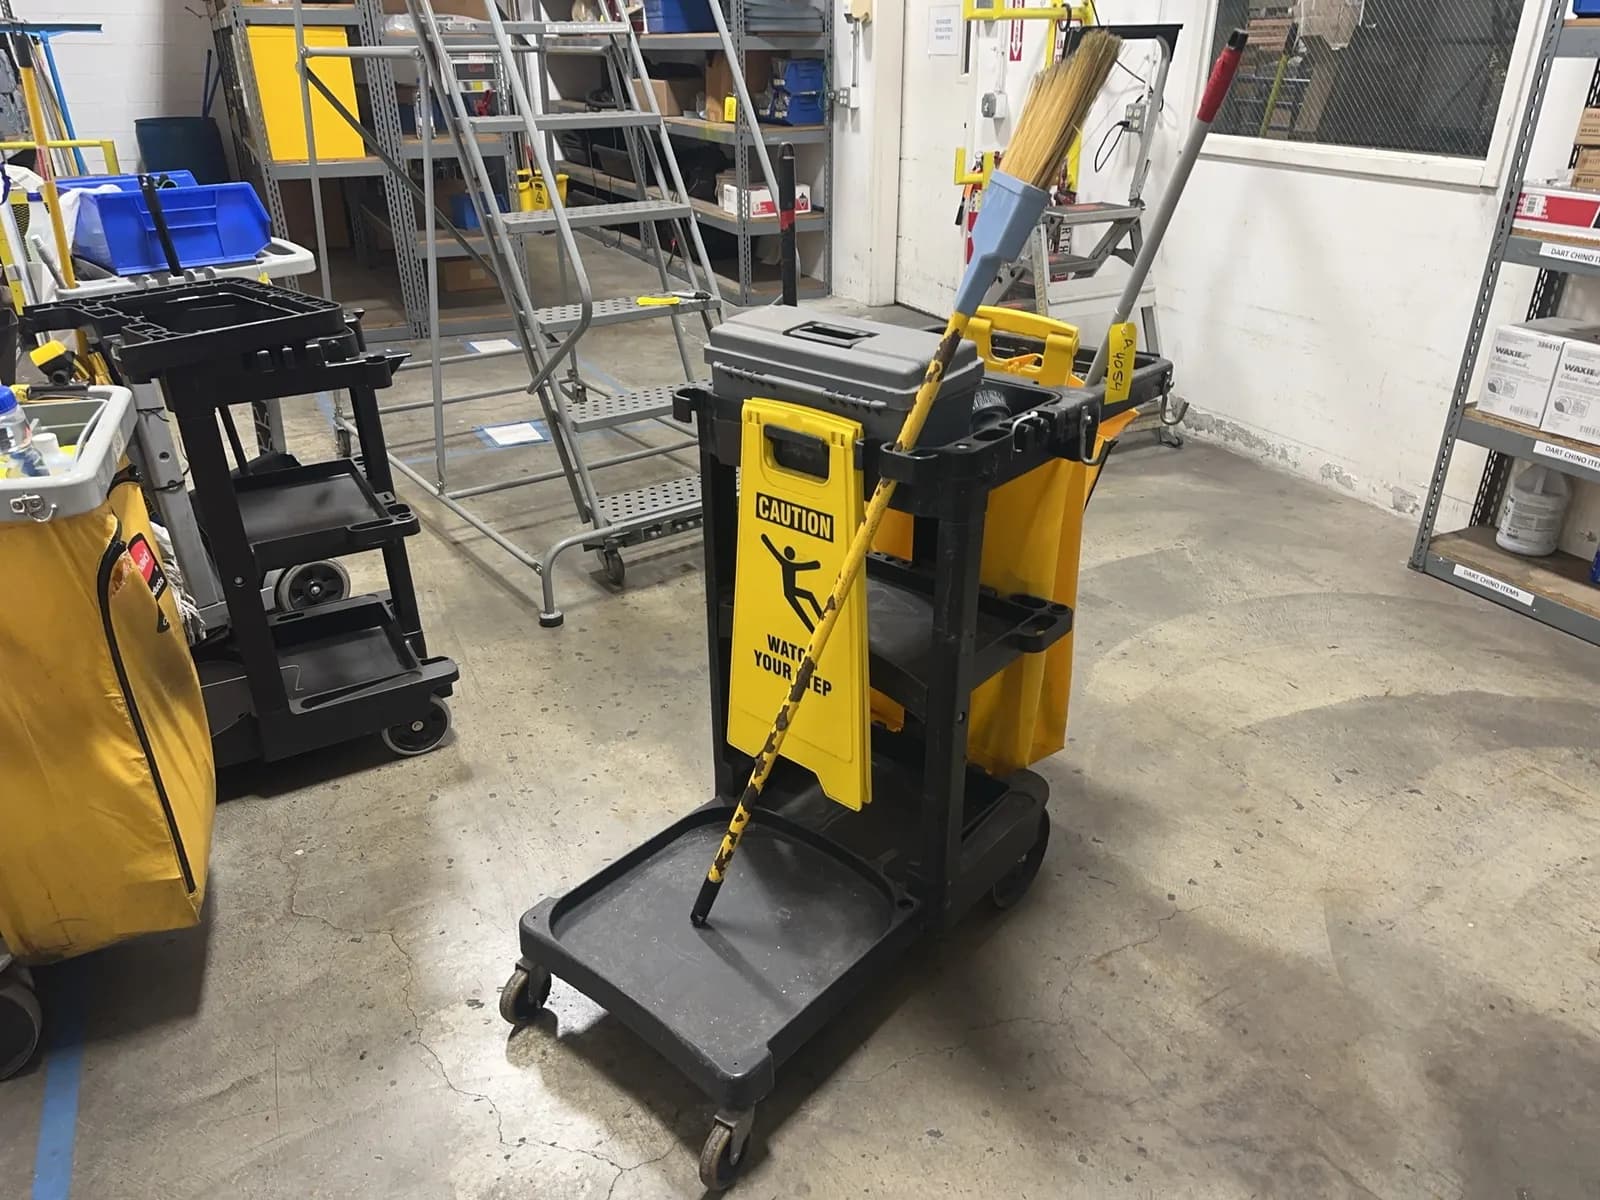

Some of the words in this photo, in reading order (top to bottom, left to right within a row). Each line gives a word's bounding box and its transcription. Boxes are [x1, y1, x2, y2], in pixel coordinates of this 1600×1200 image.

[1551, 247, 1569, 257] DART
[1570, 251, 1594, 262] CHINO
[1123, 338, 1134, 350] A
[1495, 346, 1523, 359] WAXIE
[1564, 363, 1595, 377] WAXIE
[1545, 445, 1562, 456] DART
[1564, 451, 1587, 464] CHINO
[758, 495, 831, 539] CAUTION
[1463, 569, 1479, 580] DART
[1480, 576, 1500, 590] CHINO
[1500, 585, 1519, 598] ITEMS
[767, 634, 815, 667] WATC
[753, 649, 792, 681] YOUR
[805, 674, 832, 697] TEP
